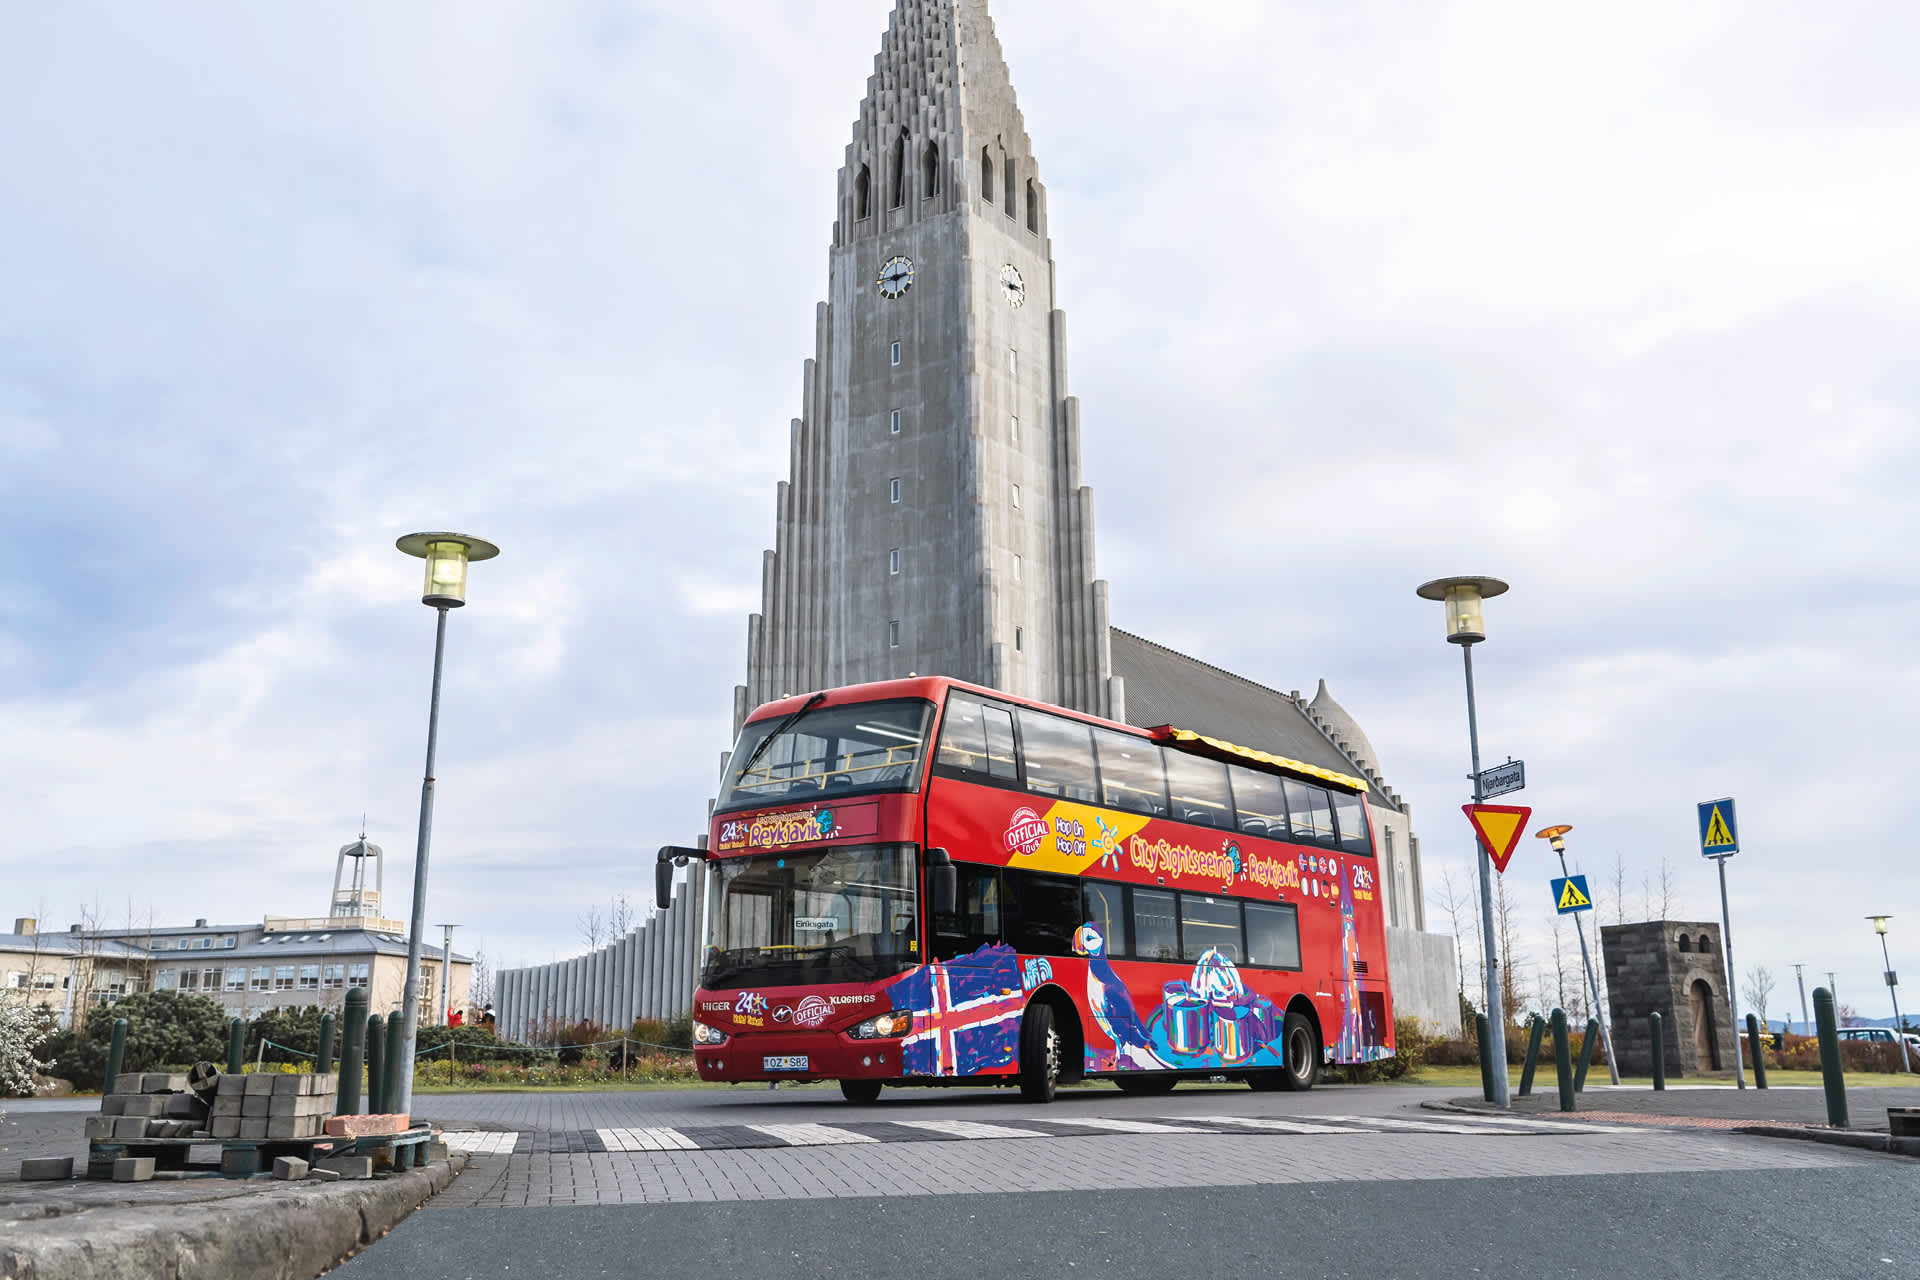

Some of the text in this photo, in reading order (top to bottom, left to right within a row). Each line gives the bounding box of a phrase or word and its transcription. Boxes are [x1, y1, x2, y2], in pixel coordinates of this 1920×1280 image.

[749, 817, 822, 848] Reykjavik
[1008, 822, 1049, 846] OFFICIAL
[1055, 816, 1072, 836] Hop
[1073, 819, 1084, 838] On
[1022, 840, 1040, 853] TOUR
[1056, 837, 1086, 856] Hop Off
[1248, 853, 1299, 890] Reykjavik
[702, 1002, 730, 1011] HIGER
[796, 1004, 833, 1022] OFFICIAL
[807, 1017, 824, 1026] TOUR
